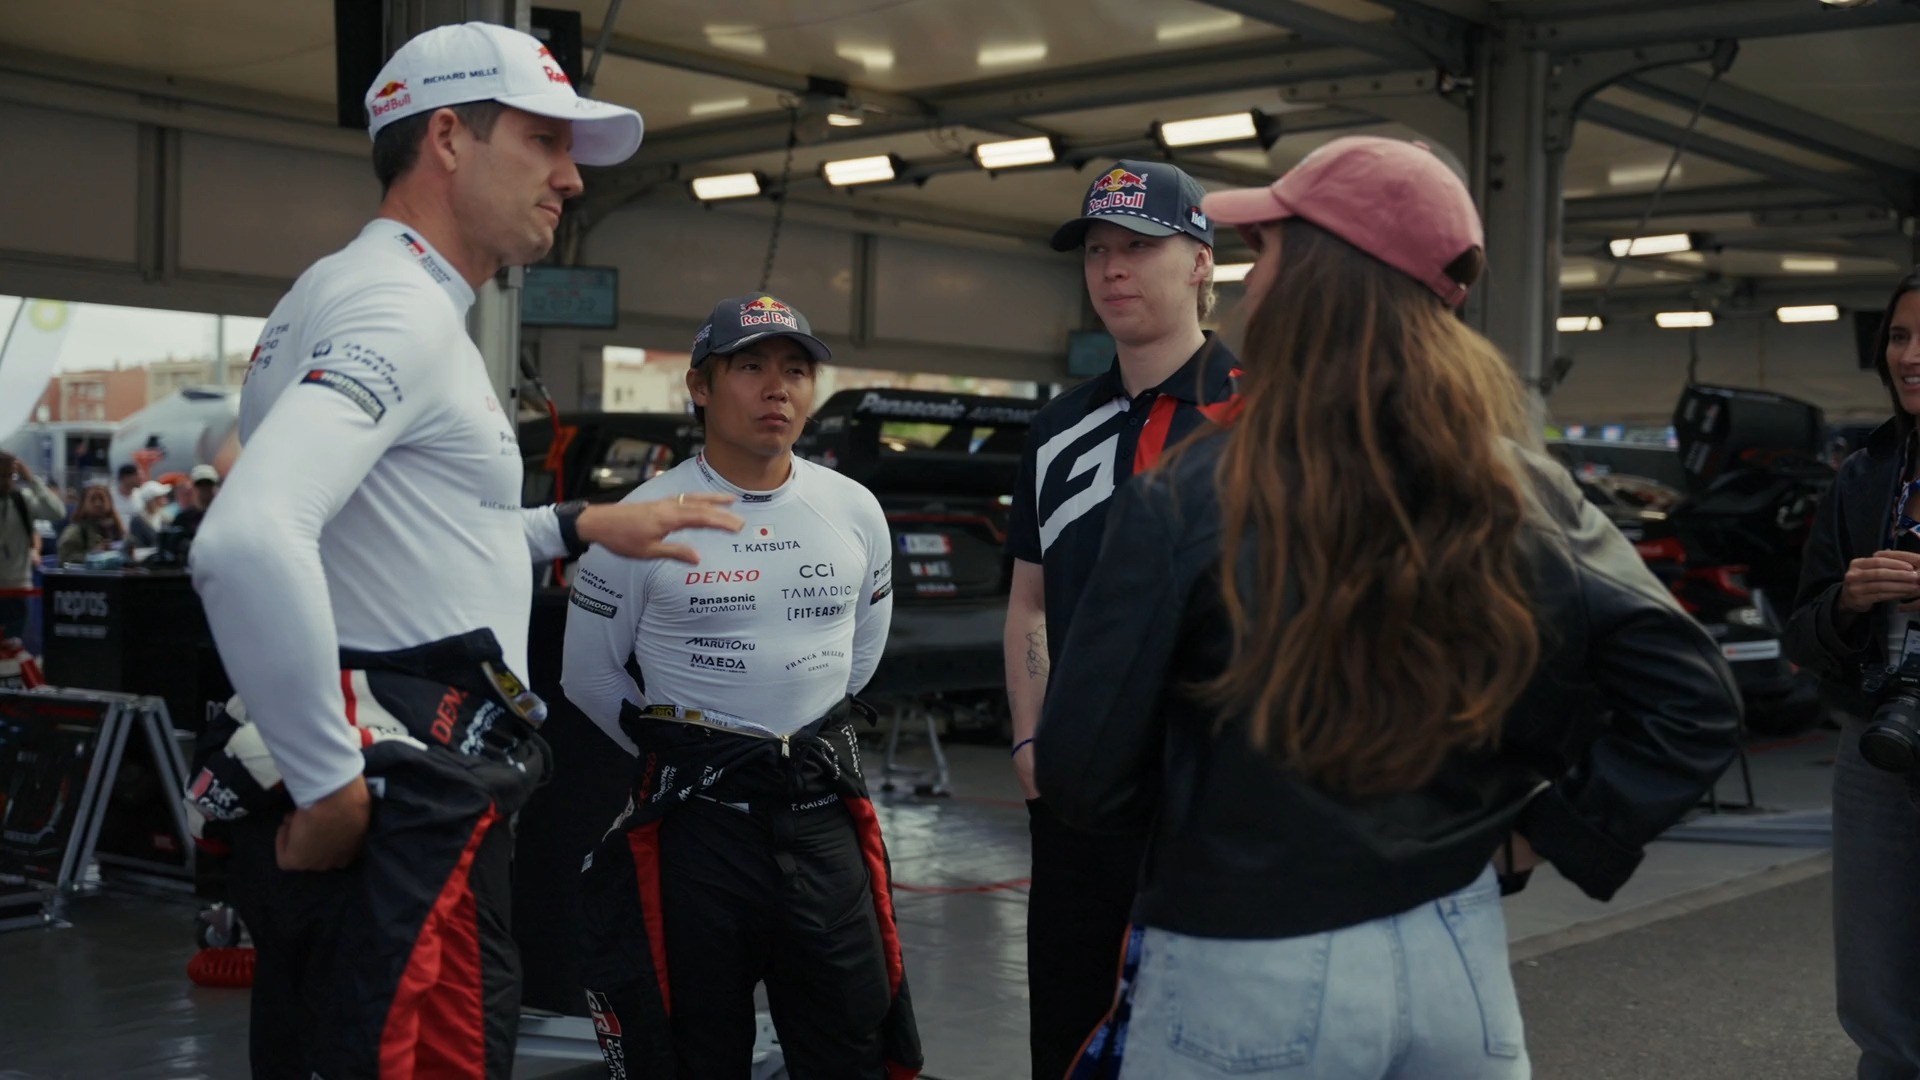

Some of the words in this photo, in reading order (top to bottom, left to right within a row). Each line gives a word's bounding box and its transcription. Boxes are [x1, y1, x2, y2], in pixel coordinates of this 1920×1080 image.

[423, 72, 466, 85] RICHARD
[469, 67, 499, 78] MILLE
[372, 101, 390, 117] Red
[391, 93, 411, 110] Bull
[1087, 192, 1112, 215] Red
[1111, 191, 1146, 209] Bull
[740, 311, 771, 327] Red
[771, 311, 798, 330] Bull
[732, 543, 742, 553] T.
[745, 540, 801, 552] KATSUTA
[581, 567, 607, 585] JAPAN
[685, 569, 760, 585] DENSO
[580, 575, 624, 599] AIRLINES
[781, 585, 852, 600] TAMADIC
[688, 603, 757, 614] AUTOMOTIVE
[690, 593, 756, 606] Panasonic
[685, 637, 756, 651] MARUTOKU
[690, 653, 746, 669] MAEDA
[785, 653, 817, 671] FRANCK
[430, 685, 470, 746] DEN
[613, 1039, 628, 1080] TOYO
